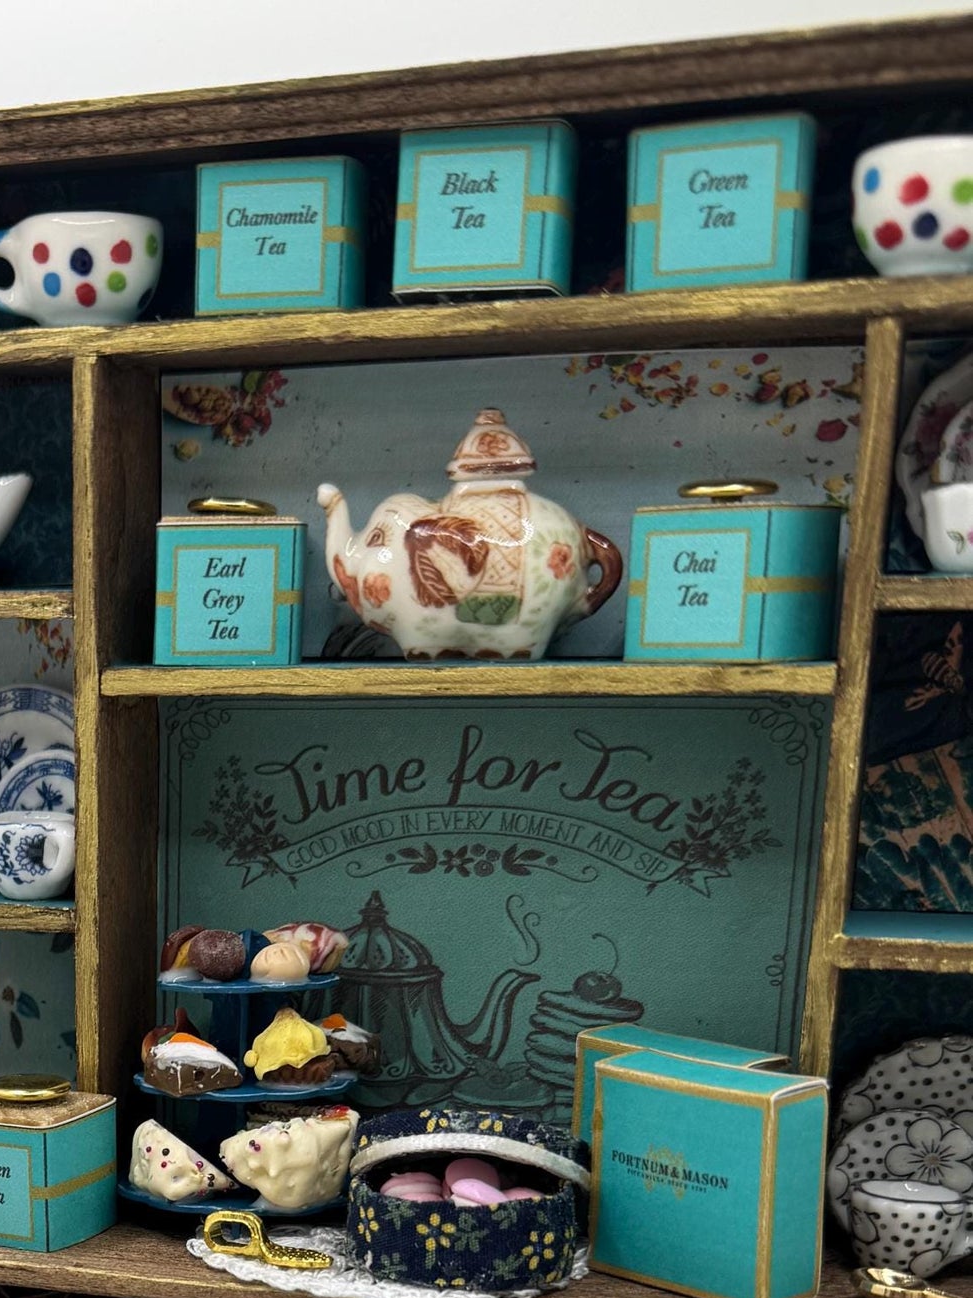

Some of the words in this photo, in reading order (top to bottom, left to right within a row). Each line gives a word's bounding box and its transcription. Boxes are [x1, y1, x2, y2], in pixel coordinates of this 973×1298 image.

[440, 170, 499, 195] Black
[689, 169, 748, 195] Green
[227, 205, 318, 228] Chamomile
[451, 205, 486, 229] Tea
[699, 204, 736, 229] Tea
[255, 236, 286, 255] Tea
[203, 557, 246, 578] Earl
[673, 550, 718, 574] Chai
[202, 588, 245, 615] Grey
[678, 584, 709, 607] Tea
[208, 619, 239, 640] Tea
[254, 745, 426, 824] Time
[447, 725, 562, 806] for
[559, 728, 680, 832] Tea
[286, 836, 337, 869] GOOD
[342, 818, 395, 846] MOOD
[401, 812, 420, 832] IN
[427, 811, 492, 831] EVERY
[499, 812, 584, 844] MOMENT
[587, 832, 633, 861] AND
[634, 852, 668, 876] SIP
